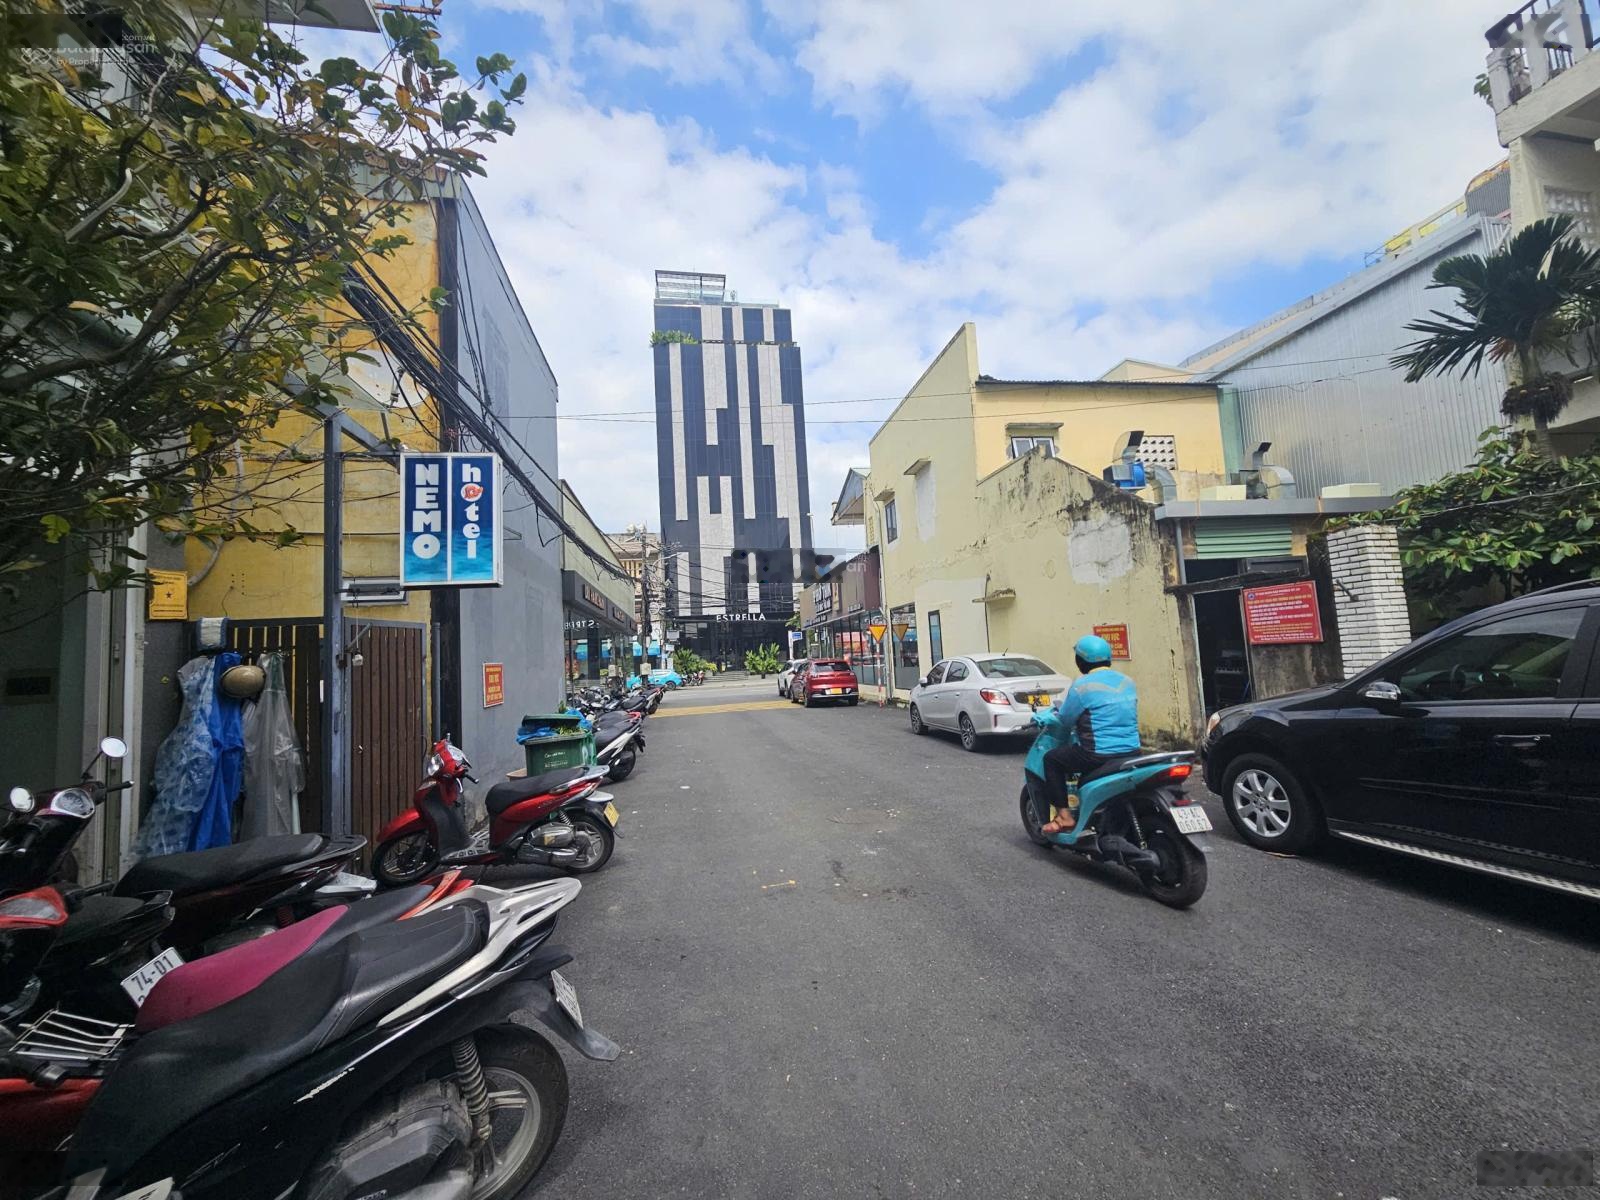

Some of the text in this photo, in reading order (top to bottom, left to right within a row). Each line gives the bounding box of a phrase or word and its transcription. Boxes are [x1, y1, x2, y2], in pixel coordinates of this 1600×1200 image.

[412, 463, 441, 559] NEMO
[460, 463, 482, 559] hotel
[716, 613, 766, 623] ESTRELLA
